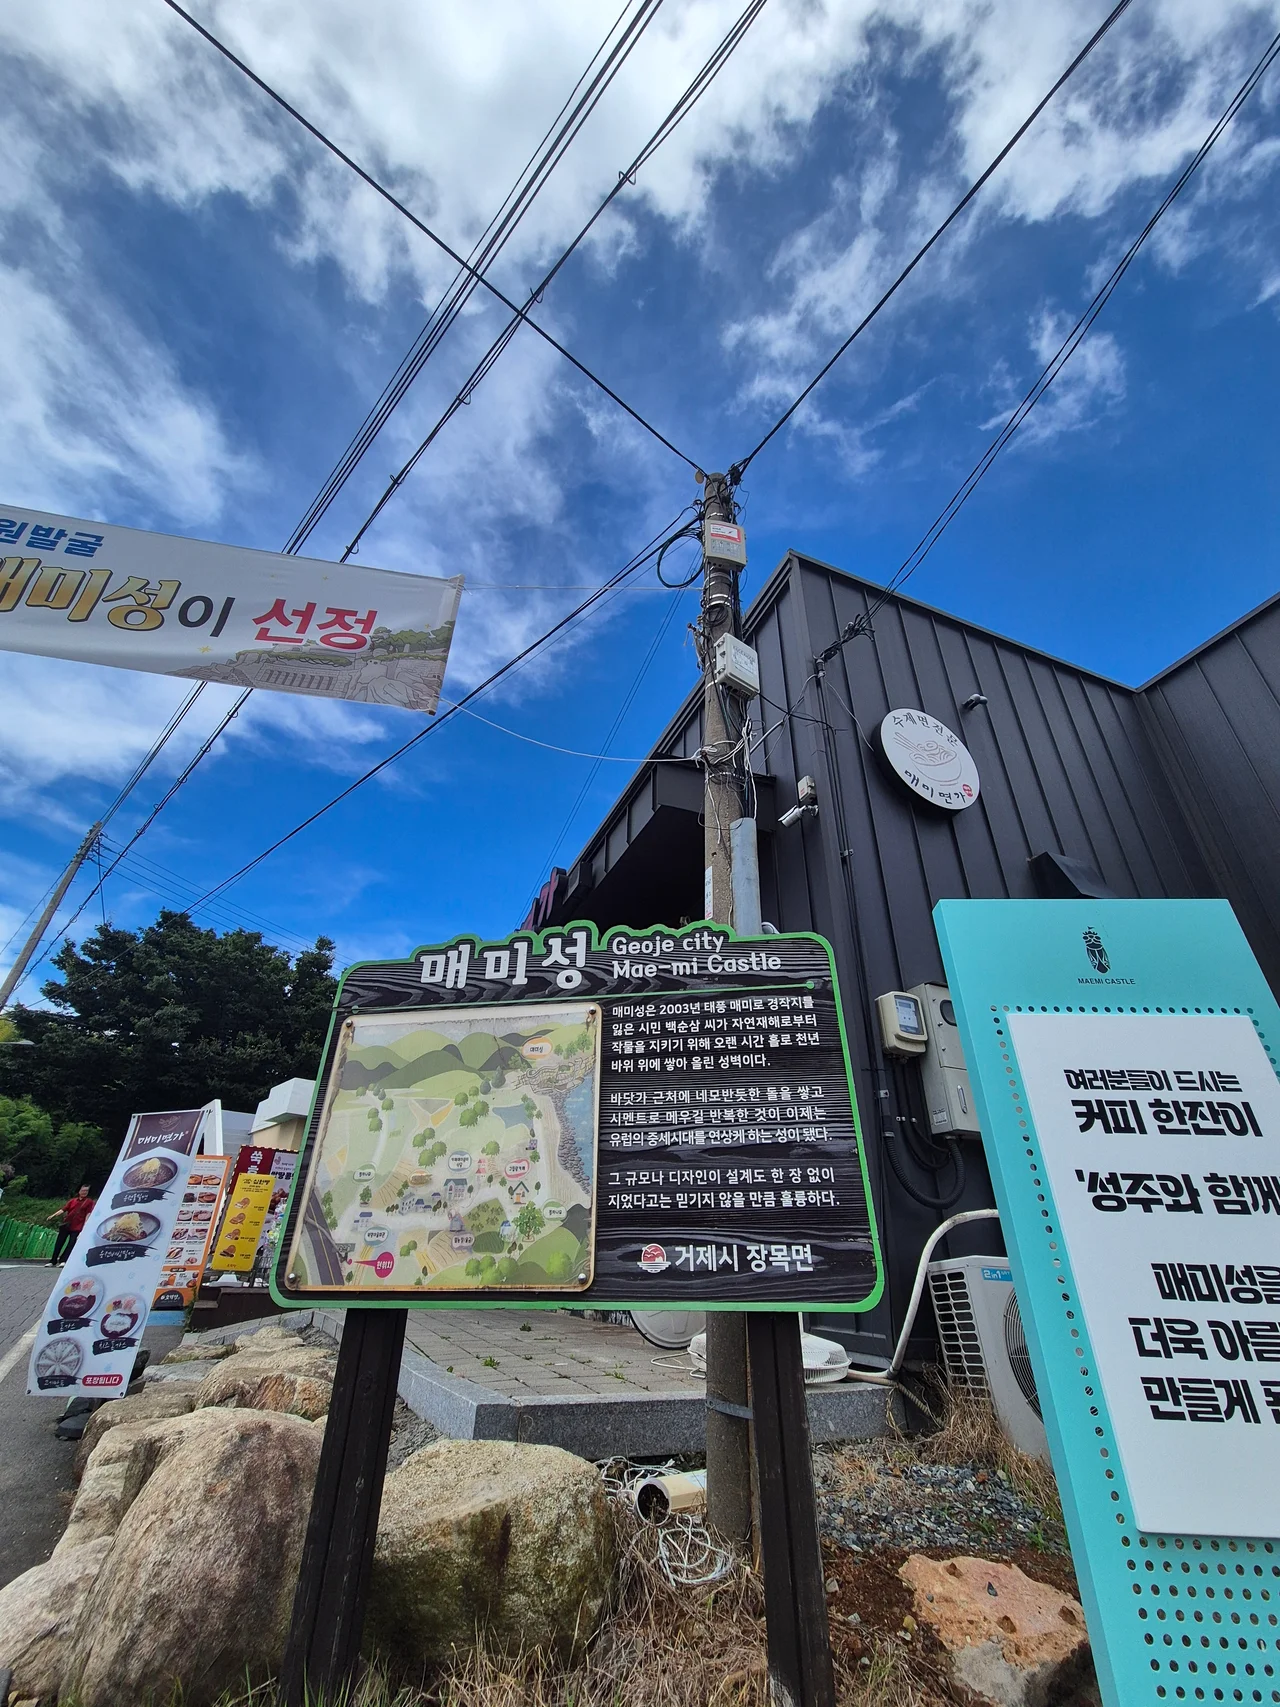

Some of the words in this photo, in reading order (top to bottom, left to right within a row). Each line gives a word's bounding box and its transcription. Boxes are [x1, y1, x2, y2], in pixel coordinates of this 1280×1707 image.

[252, 598, 378, 650] 선정
[612, 936, 674, 957] Geoje
[682, 931, 724, 953] city
[420, 931, 587, 990] 매미성
[612, 957, 698, 979] Mae-mi
[707, 952, 782, 974] Castle
[612, 1004, 657, 1018] 매미성은
[659, 1002, 701, 1015] 2003년
[704, 1001, 726, 1014] 태풍
[730, 998, 765, 1012] 매미로
[767, 995, 814, 1010] 경작지를
[612, 1022, 634, 1036] 잃은
[639, 1021, 661, 1035] 시민
[665, 1019, 701, 1033] 백순삼
[704, 1018, 728, 1032] 씨가
[732, 1014, 817, 1030] 자연재해로부터
[611, 1040, 646, 1054] 작물을
[649, 1038, 683, 1053] 지키기
[687, 1037, 711, 1051] 위해
[714, 1036, 737, 1050] 오랜
[741, 1034, 764, 1048] 시간
[768, 1033, 792, 1047] 홀로
[795, 1032, 820, 1046] 천년
[611, 1059, 634, 1073] 바위
[638, 1057, 661, 1071] 위에
[664, 1056, 688, 1070] 쌓아
[691, 1055, 714, 1070] 올린
[718, 1053, 771, 1069] 성벽이다.
[1064, 1069, 1173, 1092] 여러분들이
[1173, 1070, 1243, 1093] 드시는
[610, 1091, 648, 1106] 바닷가
[652, 1090, 690, 1104] 근처에
[696, 1087, 760, 1103] 네모반듯한
[766, 1086, 792, 1101] 돌을
[797, 1085, 824, 1099] 쌓고
[610, 1111, 660, 1126] 시멘트로
[665, 1110, 705, 1125] 메우길
[709, 1108, 749, 1123] 반복한
[754, 1107, 780, 1122] 것이
[786, 1105, 827, 1121] 이제는
[1071, 1098, 1148, 1135] 커피
[1148, 1098, 1264, 1137] 한잔이
[138, 1132, 184, 1145] 매미면가
[609, 1132, 644, 1147] 유럽의
[647, 1130, 706, 1146] 중세시대를
[709, 1129, 745, 1145] 연상케
[748, 1128, 772, 1143] 하는
[775, 1127, 800, 1143] 성이
[803, 1126, 832, 1142] 됐다.
[608, 1172, 621, 1186] 그
[625, 1170, 664, 1186] 규모나
[669, 1169, 721, 1185] 디자인이
[726, 1168, 767, 1184] 설계도
[771, 1167, 784, 1183] 한
[789, 1167, 802, 1183] 장
[807, 1167, 835, 1183] 없이
[608, 1193, 672, 1209] 지었다고는
[676, 1192, 715, 1209] 믿기지
[719, 1191, 745, 1208] 않을
[749, 1191, 776, 1207] 만큼
[780, 1190, 840, 1207] 훌륭하다.
[675, 1244, 739, 1272] 거제시
[746, 1244, 814, 1273] 장목면
[1151, 1262, 1280, 1304] 매미성을
[1128, 1317, 1208, 1360] 더욱
[85, 1375, 120, 1385] 포장됩니다
[1140, 1376, 1261, 1424] 만들게
